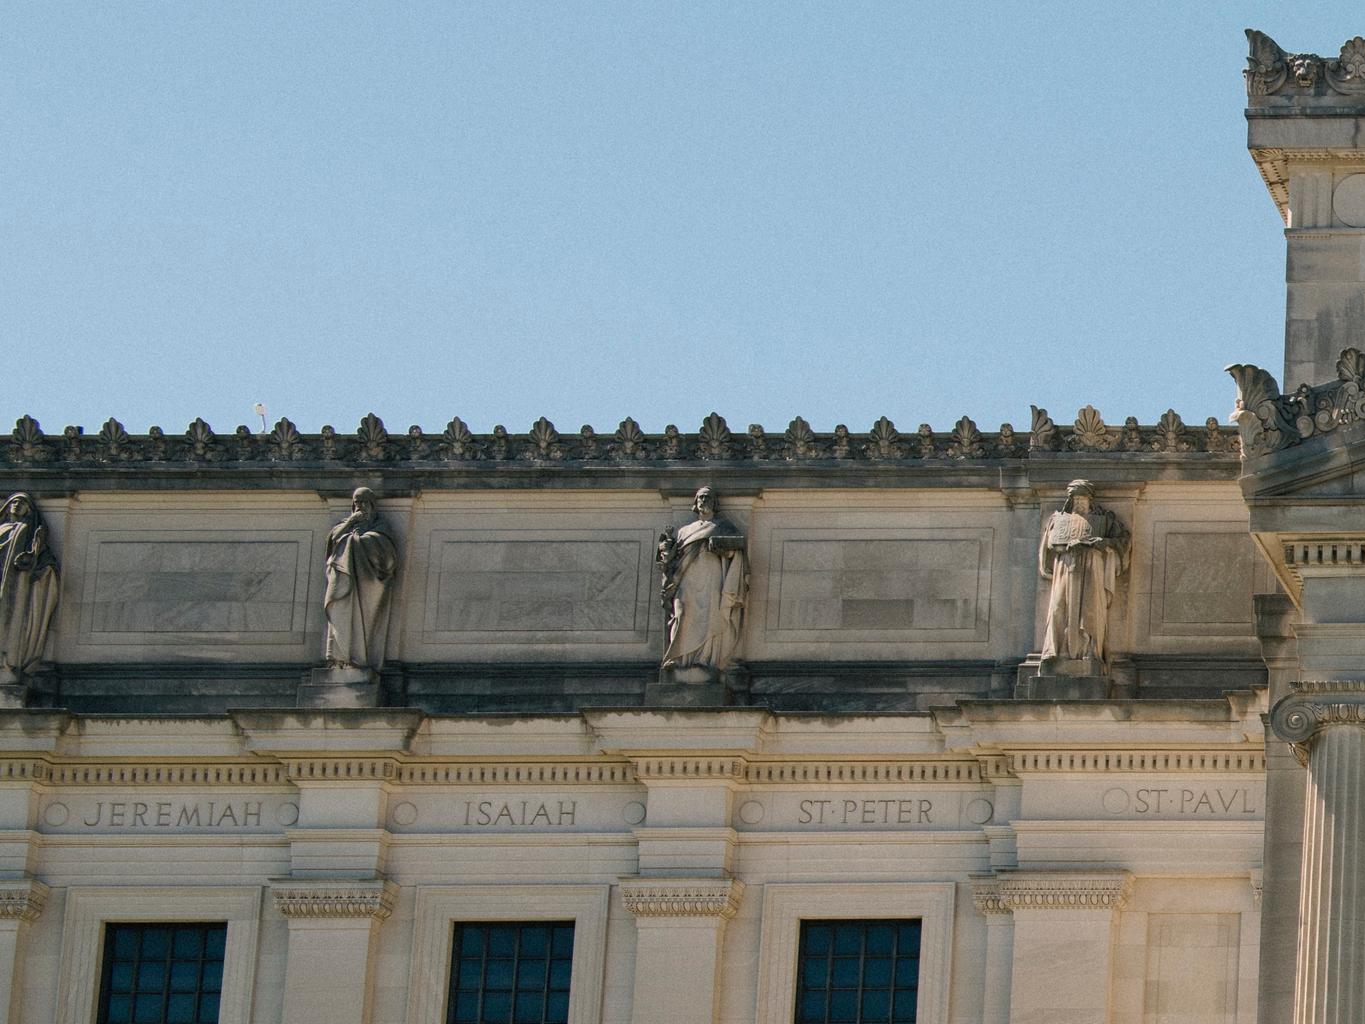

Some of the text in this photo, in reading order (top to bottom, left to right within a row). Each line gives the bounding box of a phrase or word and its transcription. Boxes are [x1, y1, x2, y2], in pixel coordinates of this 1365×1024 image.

[463, 801, 577, 826] ISAIAH
[841, 799, 933, 824] PETER
[1180, 789, 1256, 814] PAVL
[83, 802, 263, 827] JEREMIAH
